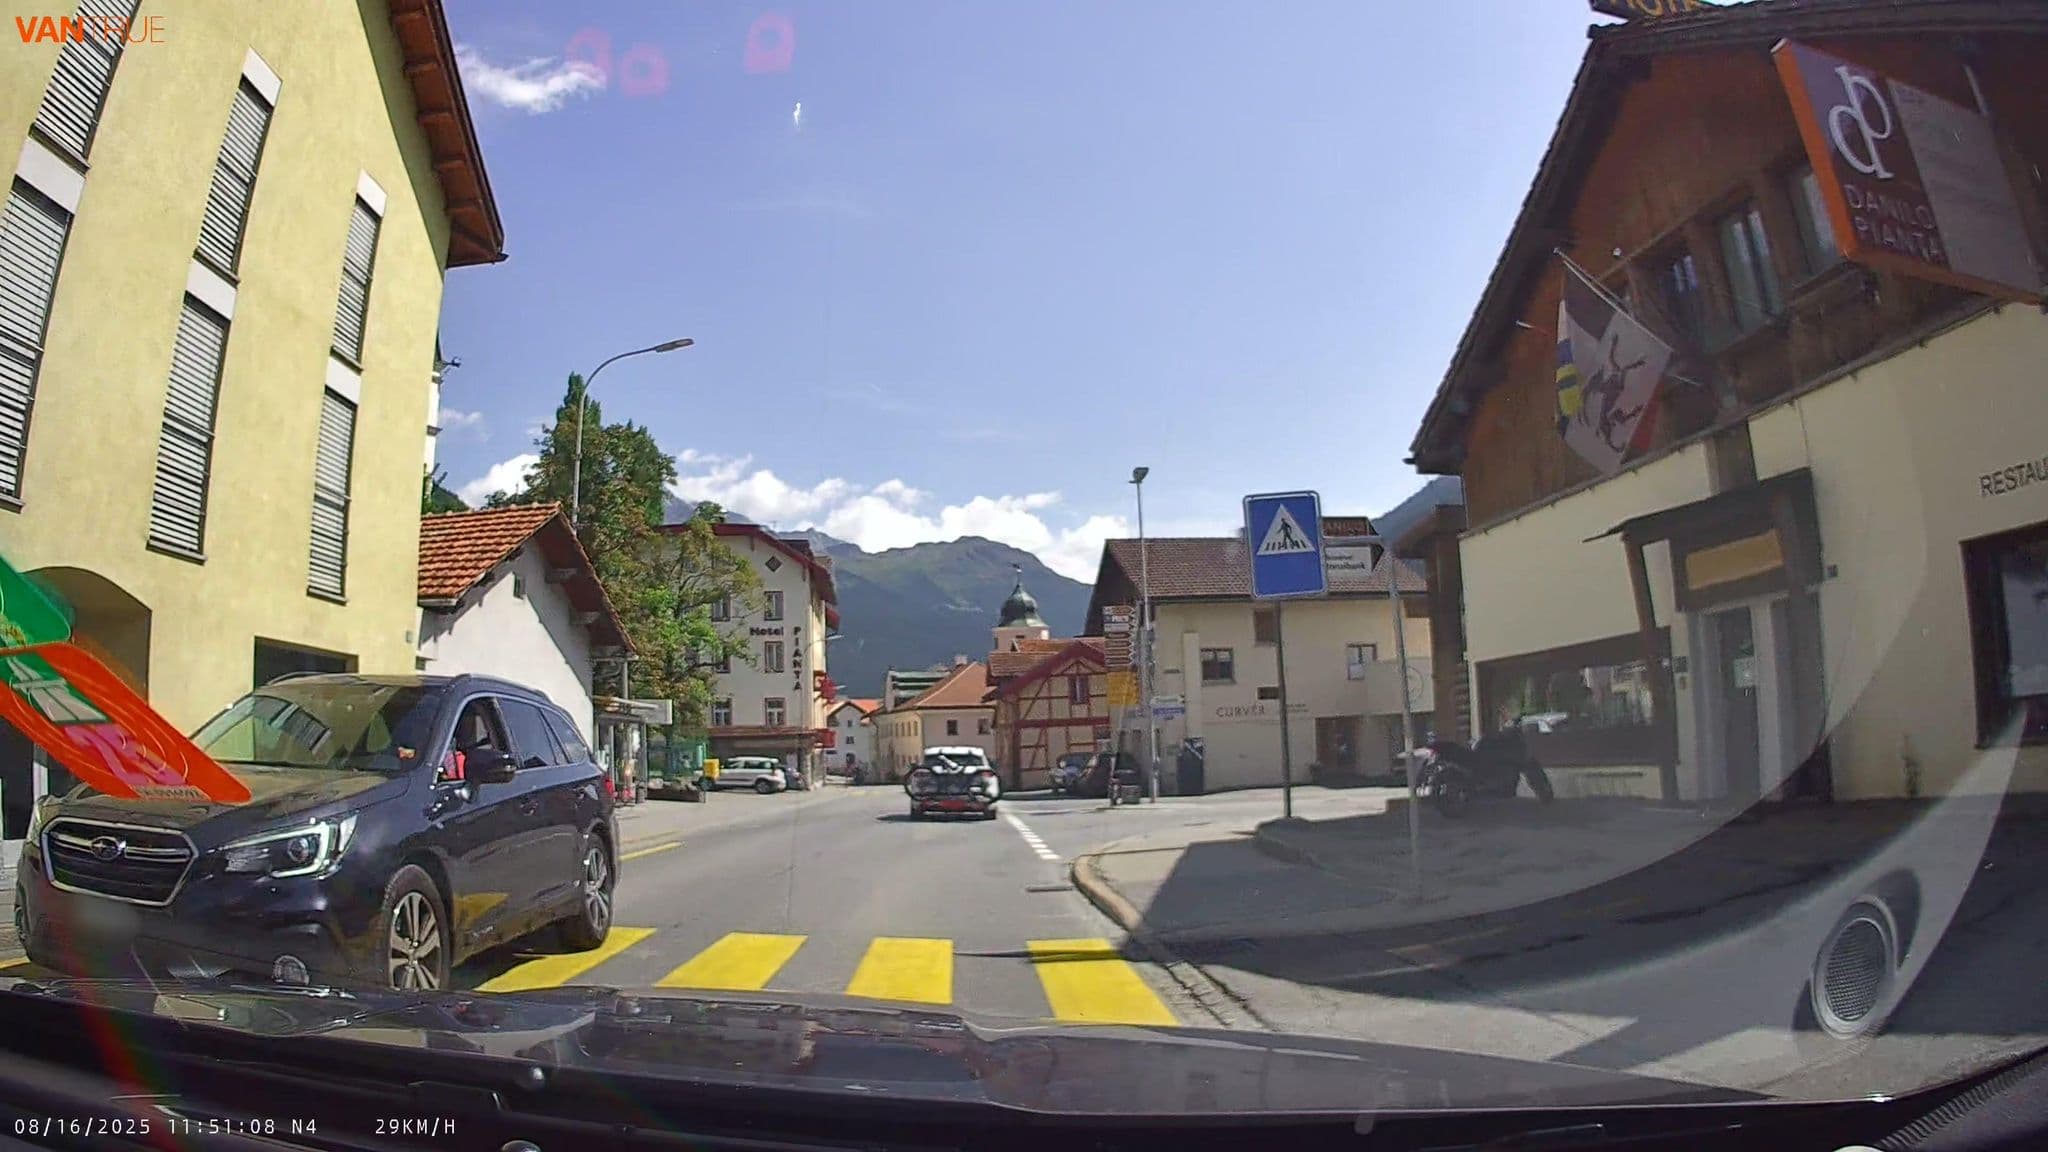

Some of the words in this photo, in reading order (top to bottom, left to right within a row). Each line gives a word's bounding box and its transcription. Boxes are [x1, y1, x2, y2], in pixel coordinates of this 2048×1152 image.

[1843, 184, 1936, 230] DANILO
[1853, 216, 1946, 264] PIANTA
[749, 626, 784, 636] Hotel
[792, 626, 802, 691] PIANTA
